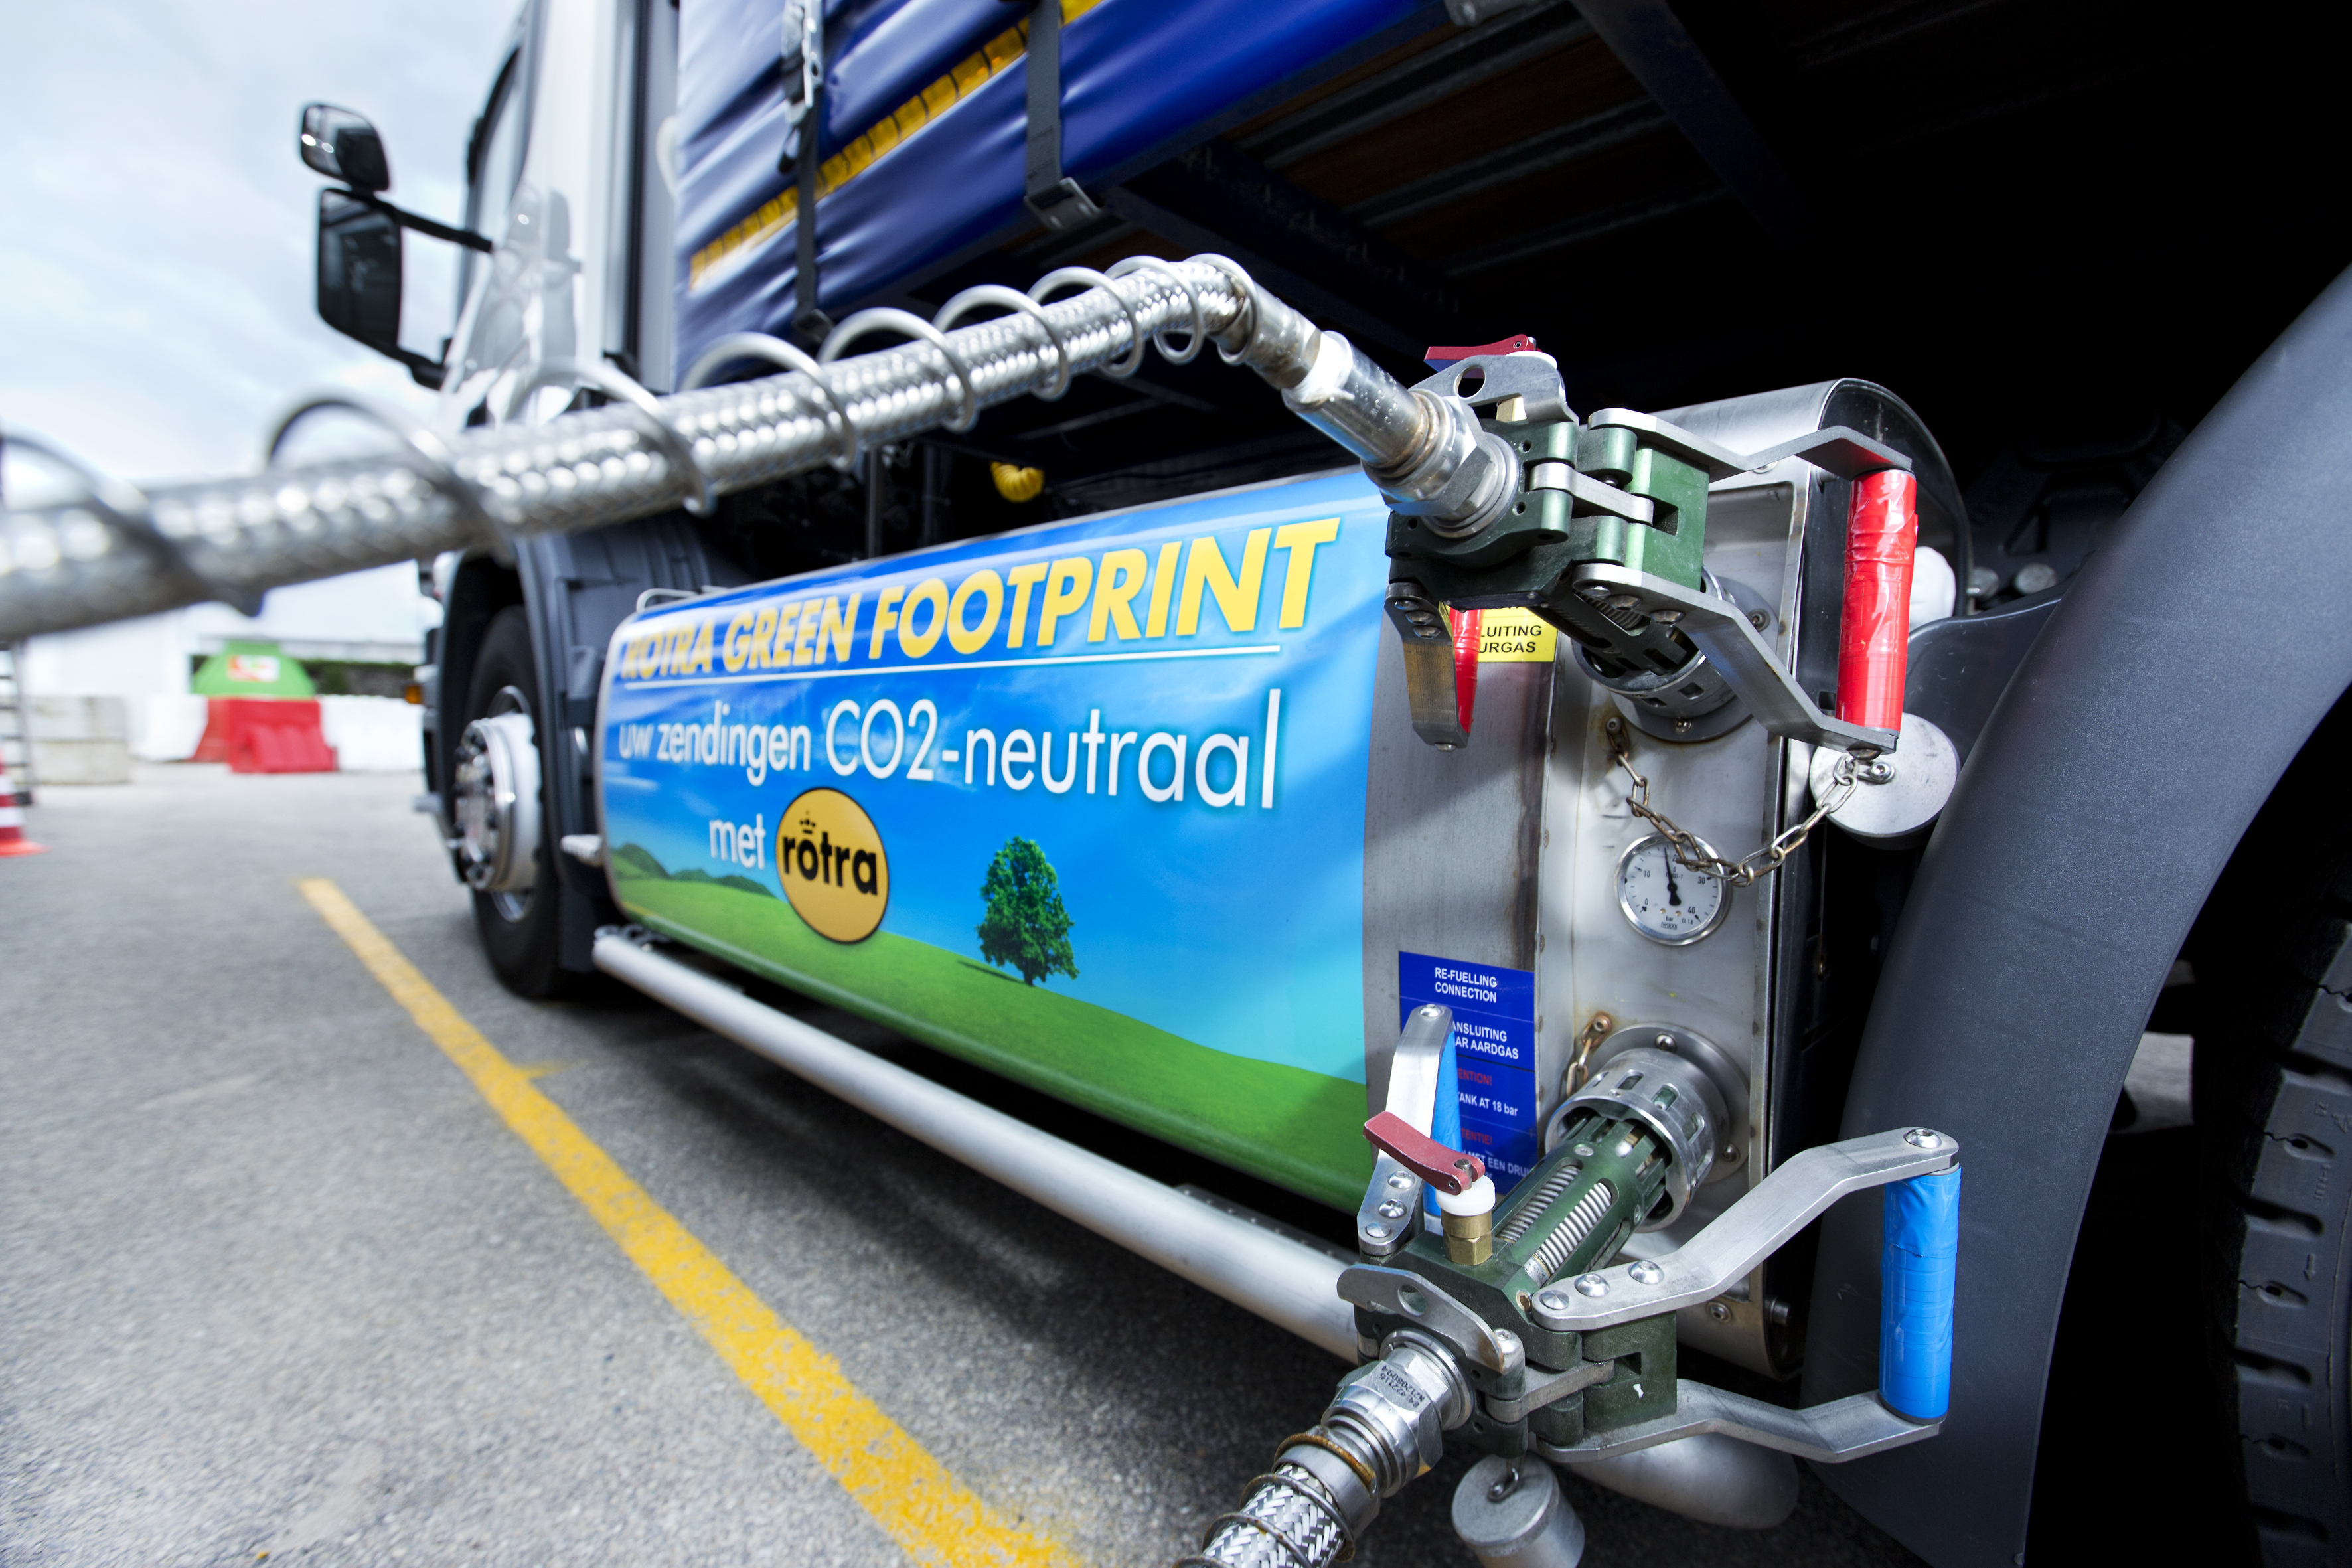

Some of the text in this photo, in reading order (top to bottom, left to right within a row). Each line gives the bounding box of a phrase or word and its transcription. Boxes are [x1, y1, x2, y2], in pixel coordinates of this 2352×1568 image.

[621, 517, 1340, 679] ROTRA GREEN FOOTPRINT
[619, 688, 1281, 809] uw zendingen CO2-neutraal
[709, 813, 766, 870] met
[1435, 967, 1498, 988] RE-FUELLING
[1435, 982, 1497, 1003] CONNECTION
[1455, 1036, 1519, 1059] AR AARDGAS
[1479, 1097, 1490, 1109] AT
[1492, 1100, 1502, 1113] 18
[1504, 1103, 1518, 1117] bar
[1488, 1157, 1506, 1171] EEN
